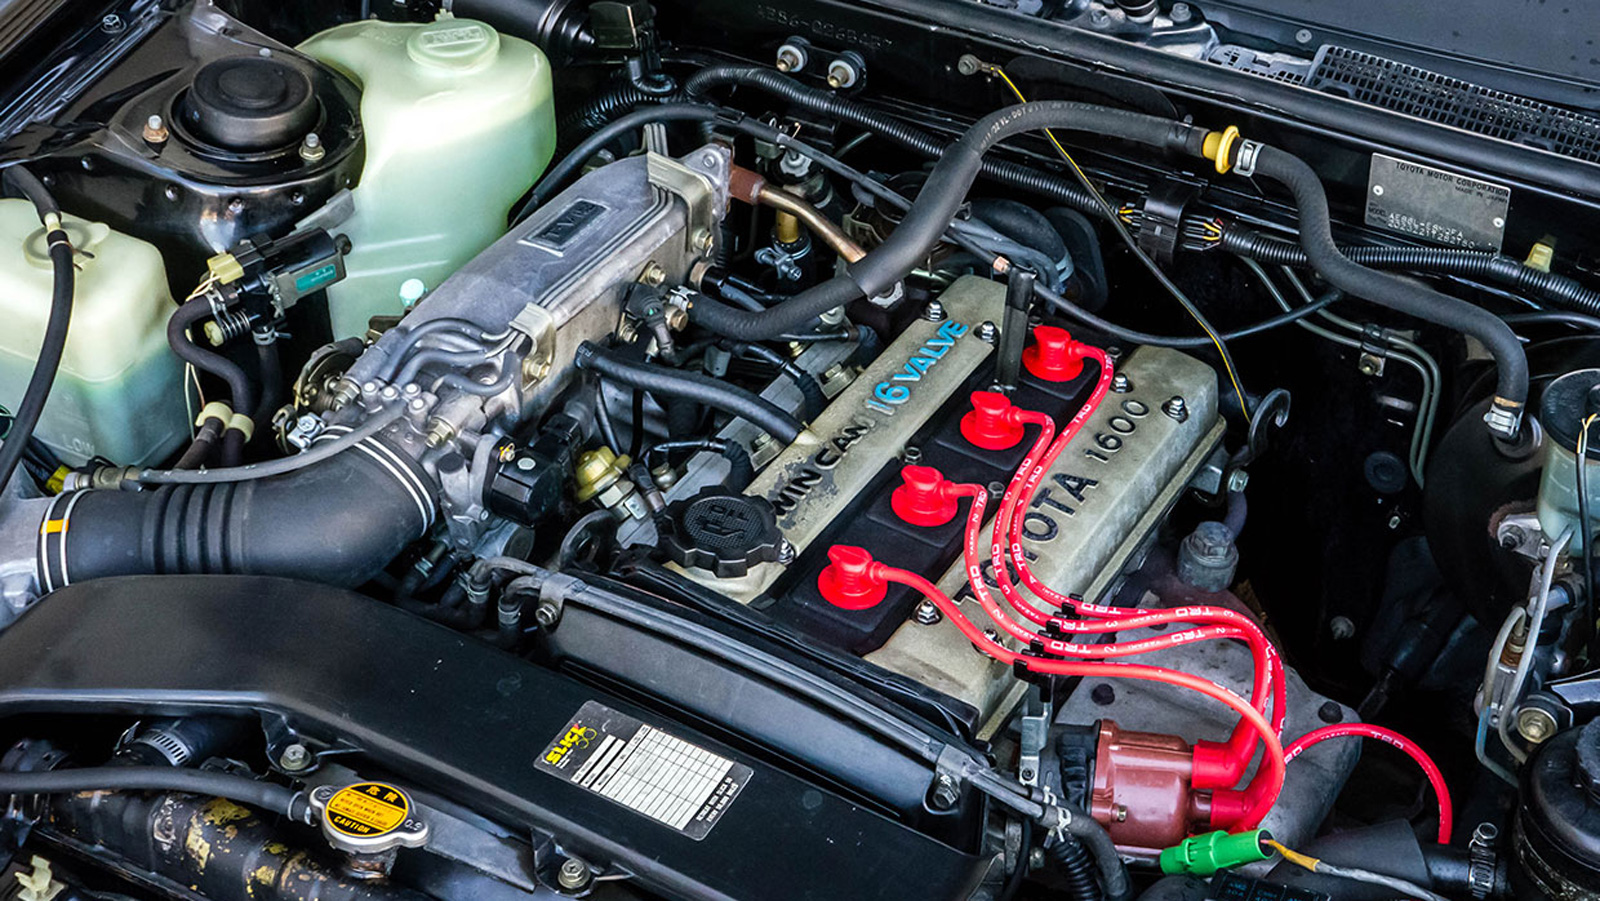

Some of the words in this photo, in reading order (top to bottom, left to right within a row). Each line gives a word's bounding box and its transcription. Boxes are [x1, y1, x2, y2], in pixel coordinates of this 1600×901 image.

[1396, 162, 1424, 175] TOYOTA
[1427, 169, 1453, 183] MOTOR
[1456, 178, 1509, 197] CORPORATION
[866, 382, 910, 416] 16
[893, 320, 969, 381] VALVE
[1072, 403, 1092, 424] TRD
[1085, 400, 1150, 464] 1600
[1012, 458, 1032, 483] TRD
[1024, 465, 1043, 490] TRD
[975, 490, 987, 508] TRD
[991, 543, 1003, 577] TRD
[1012, 543, 1025, 571] TRD
[970, 565, 989, 600] TRD
[1002, 584, 1011, 595] 3
[992, 608, 1004, 620] 2
[1081, 602, 1121, 615] TRD
[1175, 607, 1213, 617] TRD
[1105, 620, 1118, 628] 3
[1171, 629, 1205, 643] TRD
[1051, 641, 1091, 654] TRD
[1104, 645, 1117, 653] 2
[545, 723, 587, 766] SLICK
[1370, 731, 1404, 750] TRD
[333, 816, 371, 834] CAUTION
[404, 819, 423, 831] 0.9
